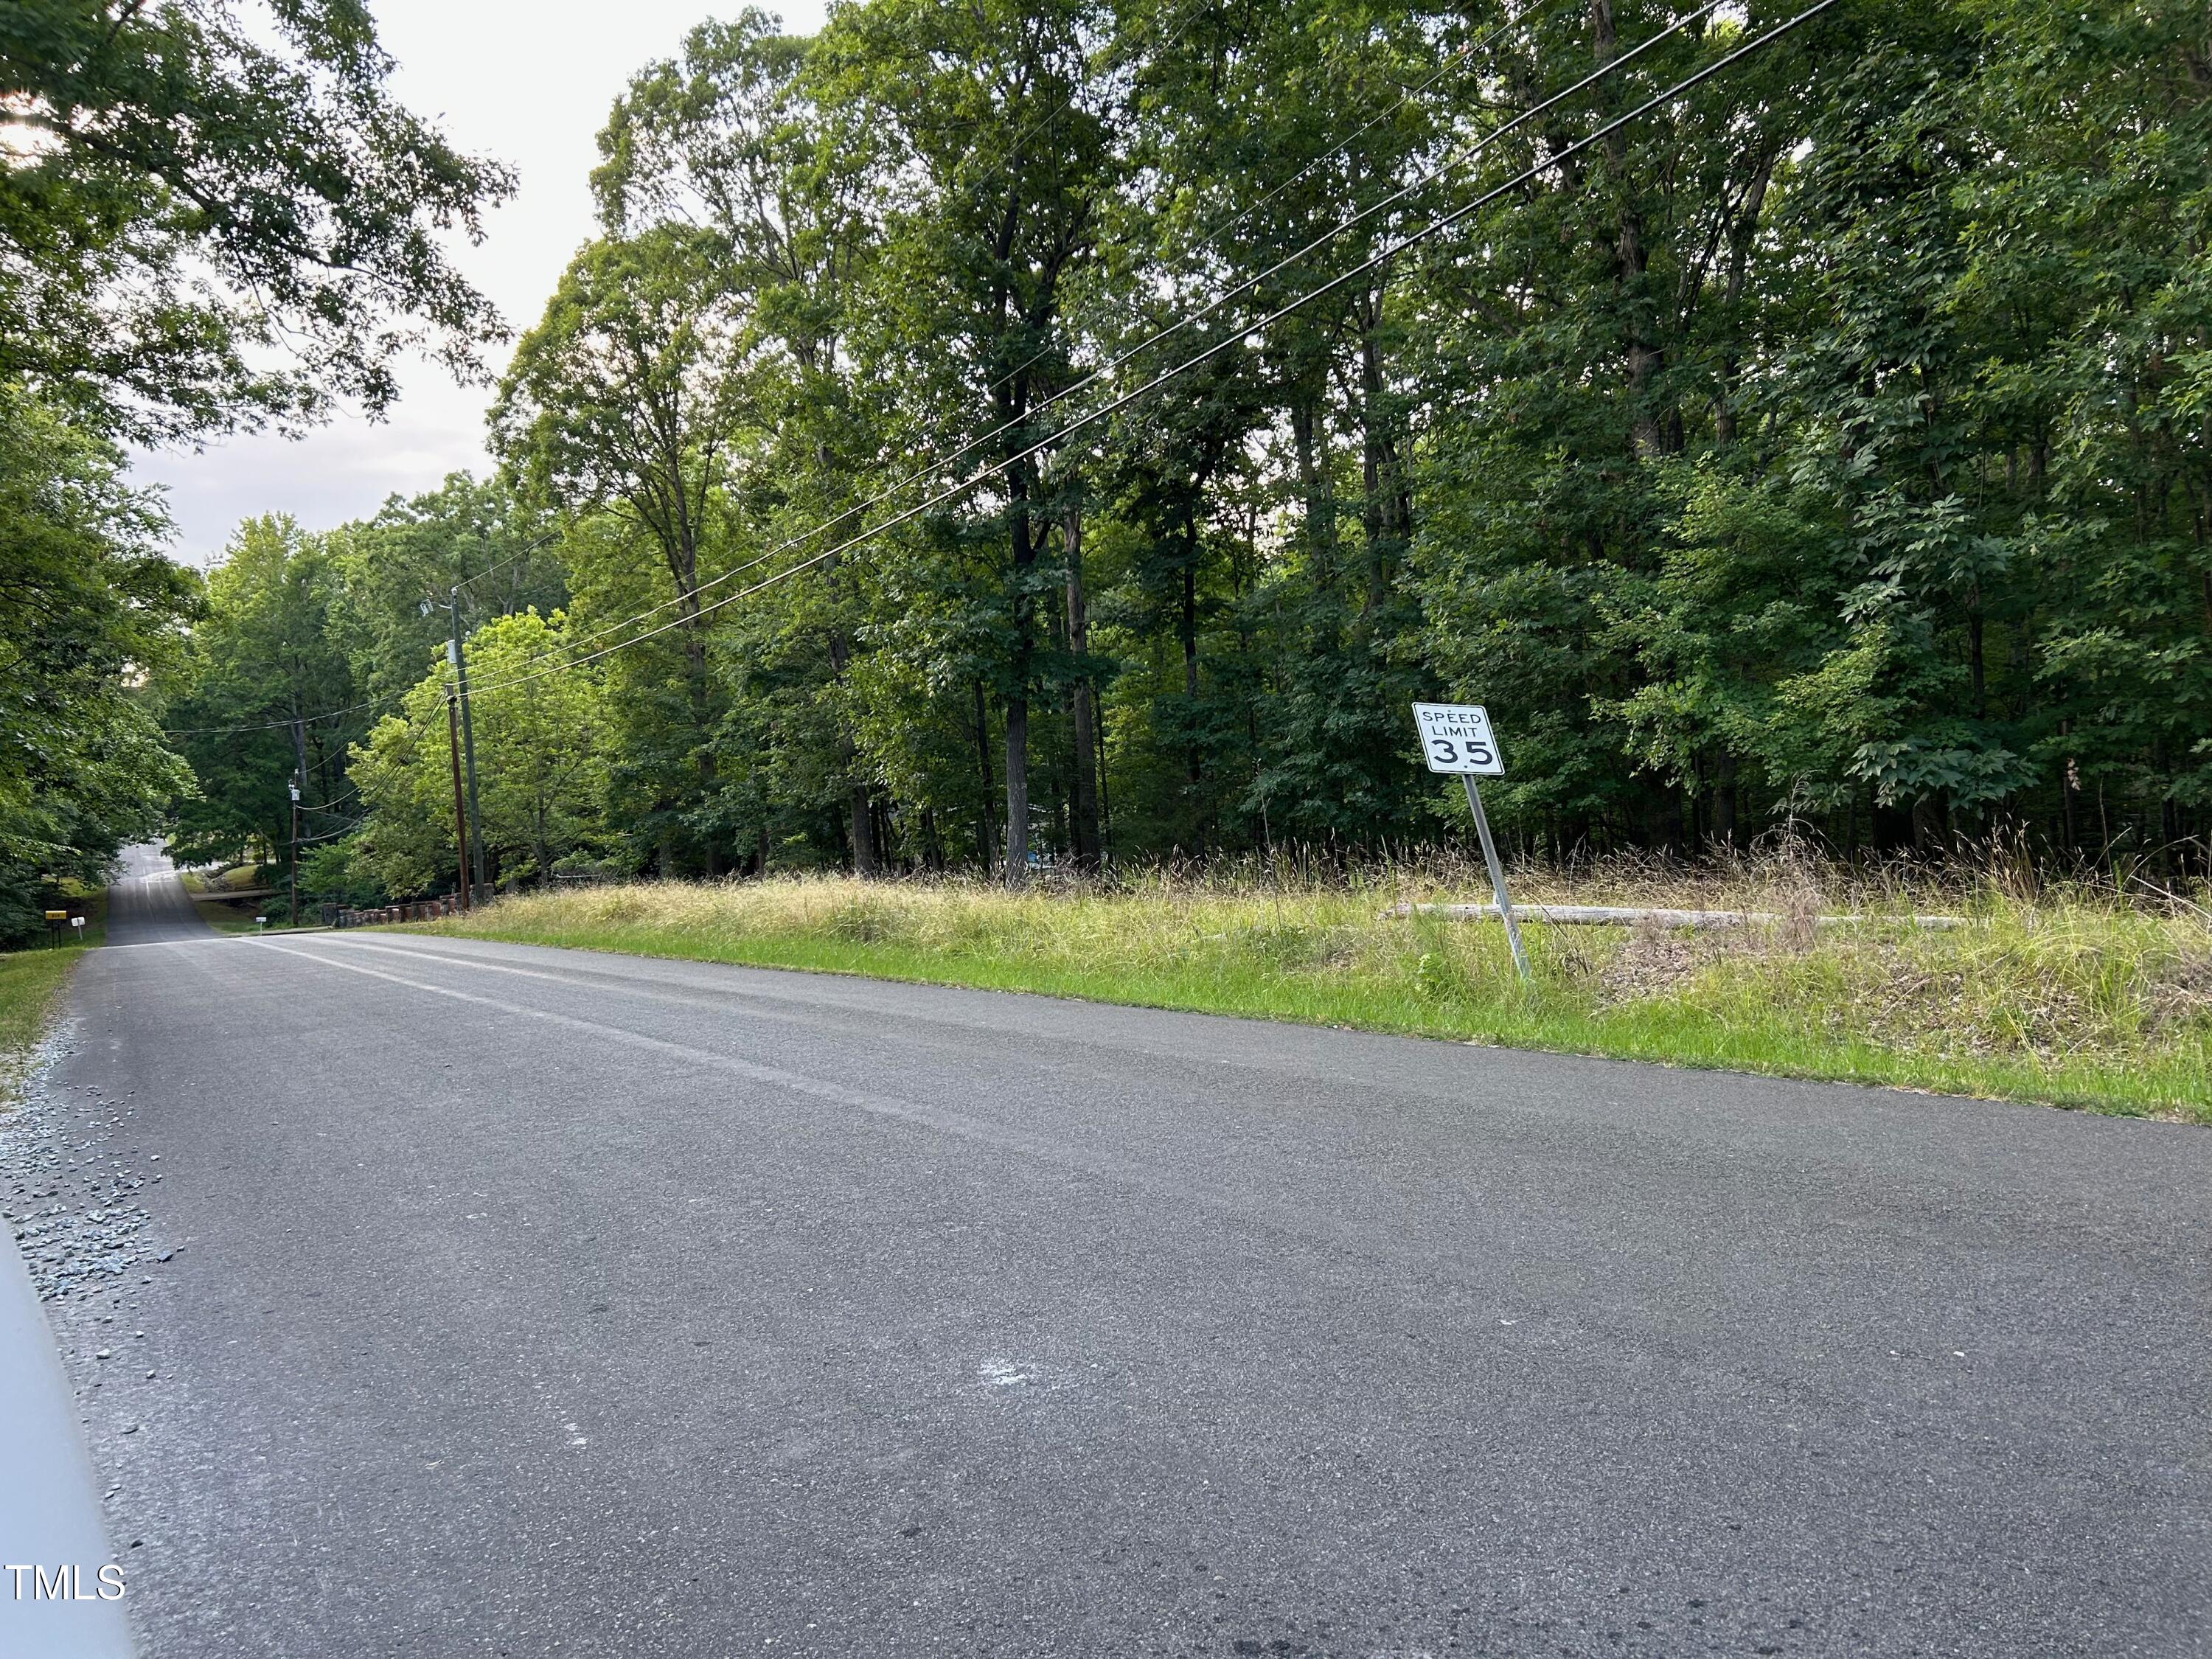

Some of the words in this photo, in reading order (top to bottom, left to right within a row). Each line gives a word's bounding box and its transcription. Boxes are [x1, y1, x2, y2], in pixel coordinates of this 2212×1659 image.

[1422, 712, 1481, 723] SPEED
[1432, 726, 1478, 737] LIMIT
[1430, 740, 1493, 765] 35
